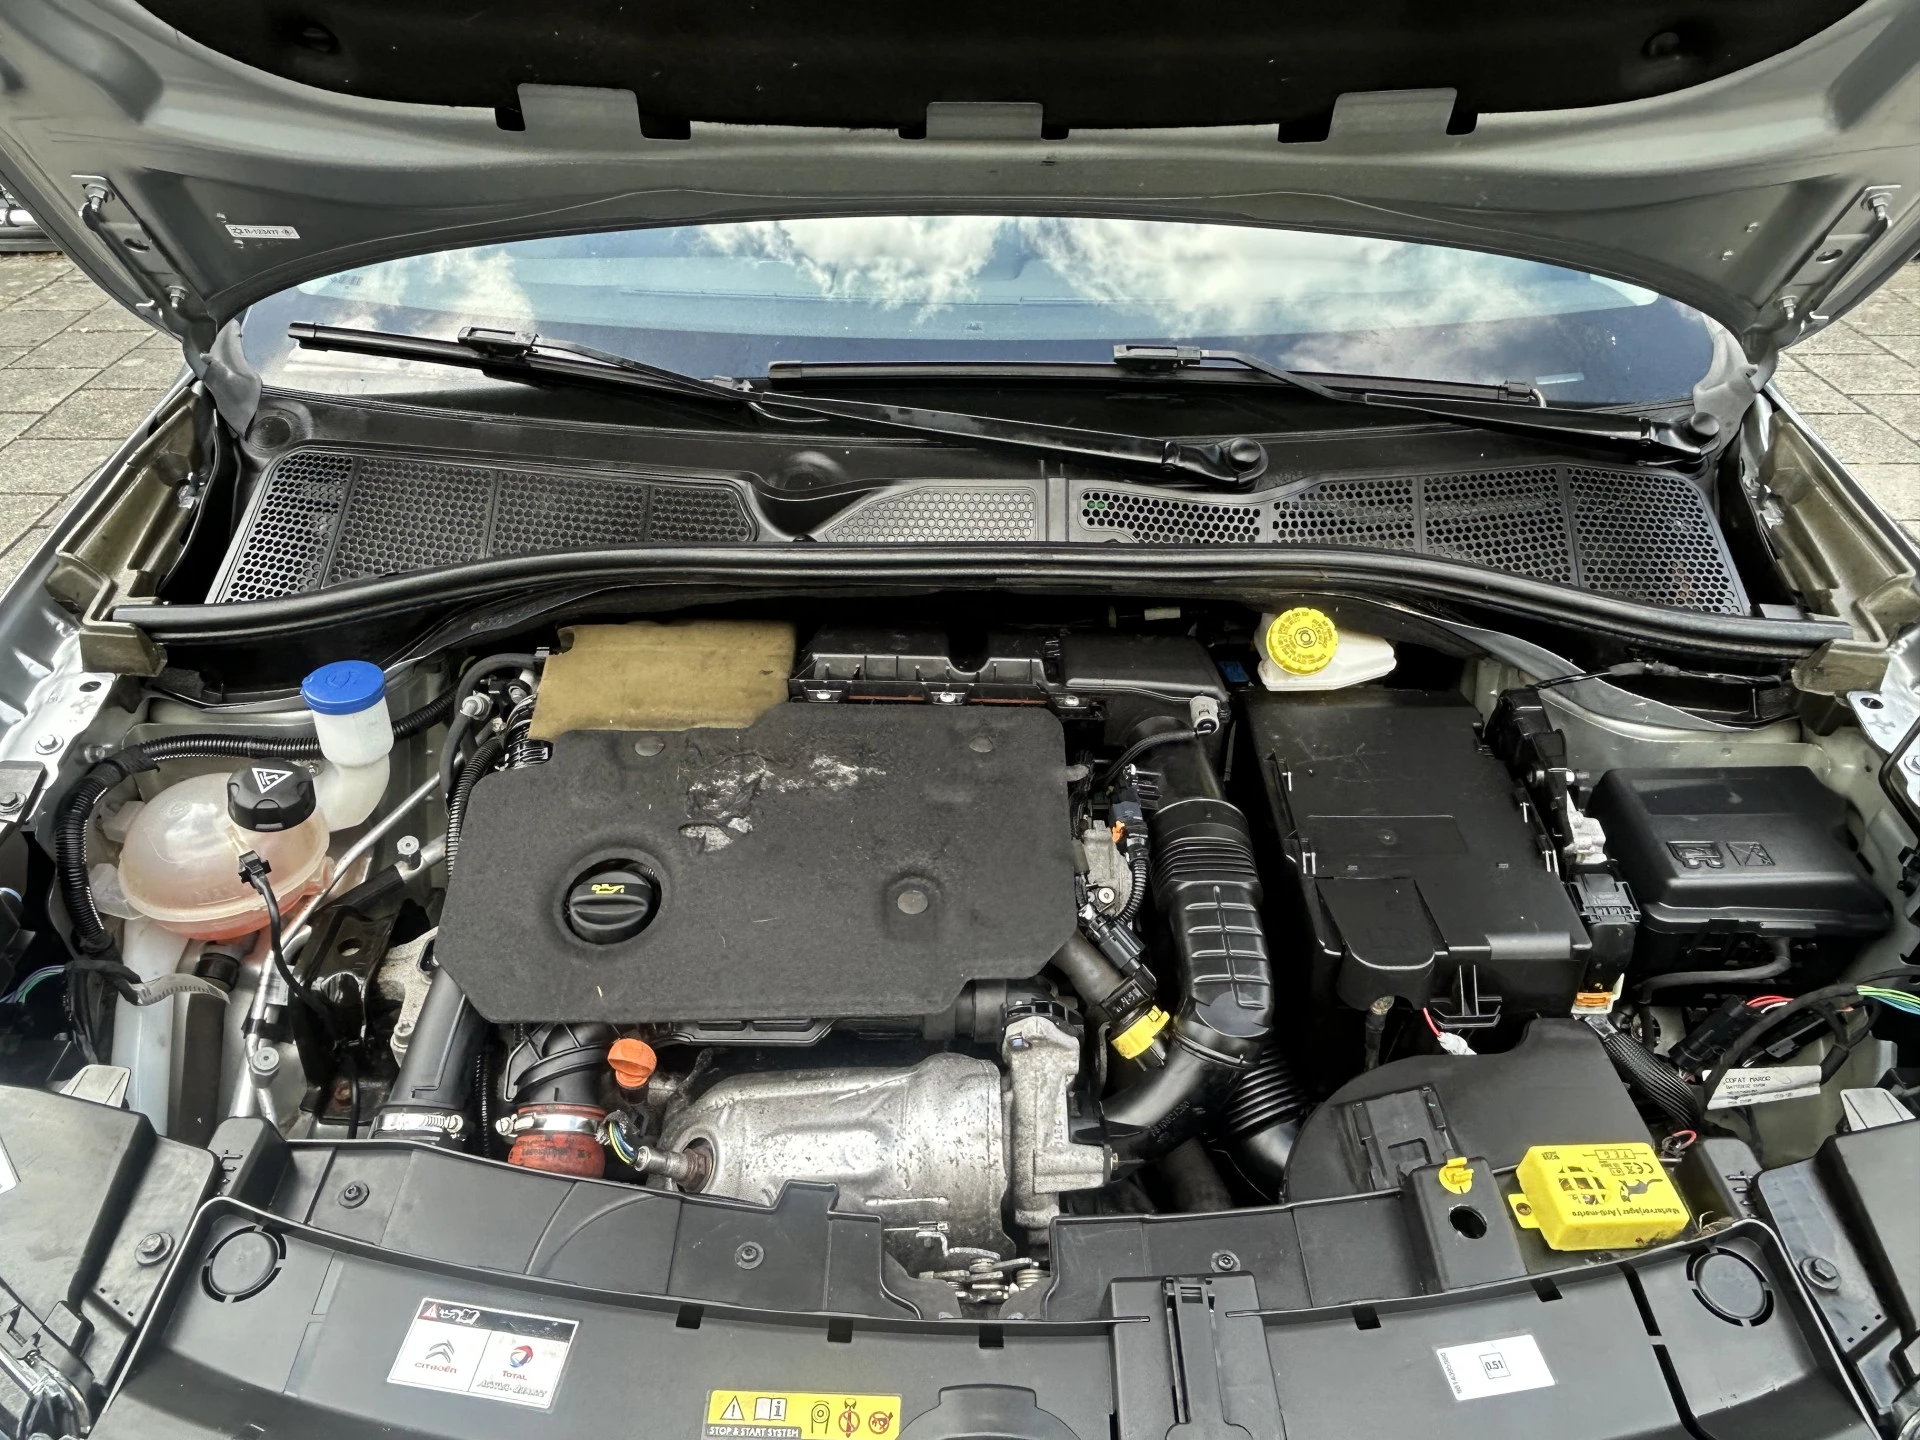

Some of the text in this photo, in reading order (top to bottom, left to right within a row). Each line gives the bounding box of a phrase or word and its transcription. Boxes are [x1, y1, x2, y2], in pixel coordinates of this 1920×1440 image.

[709, 1426, 733, 1436] STOP
[740, 1427, 766, 1437] START
[767, 1427, 800, 1438] SYSTEM
